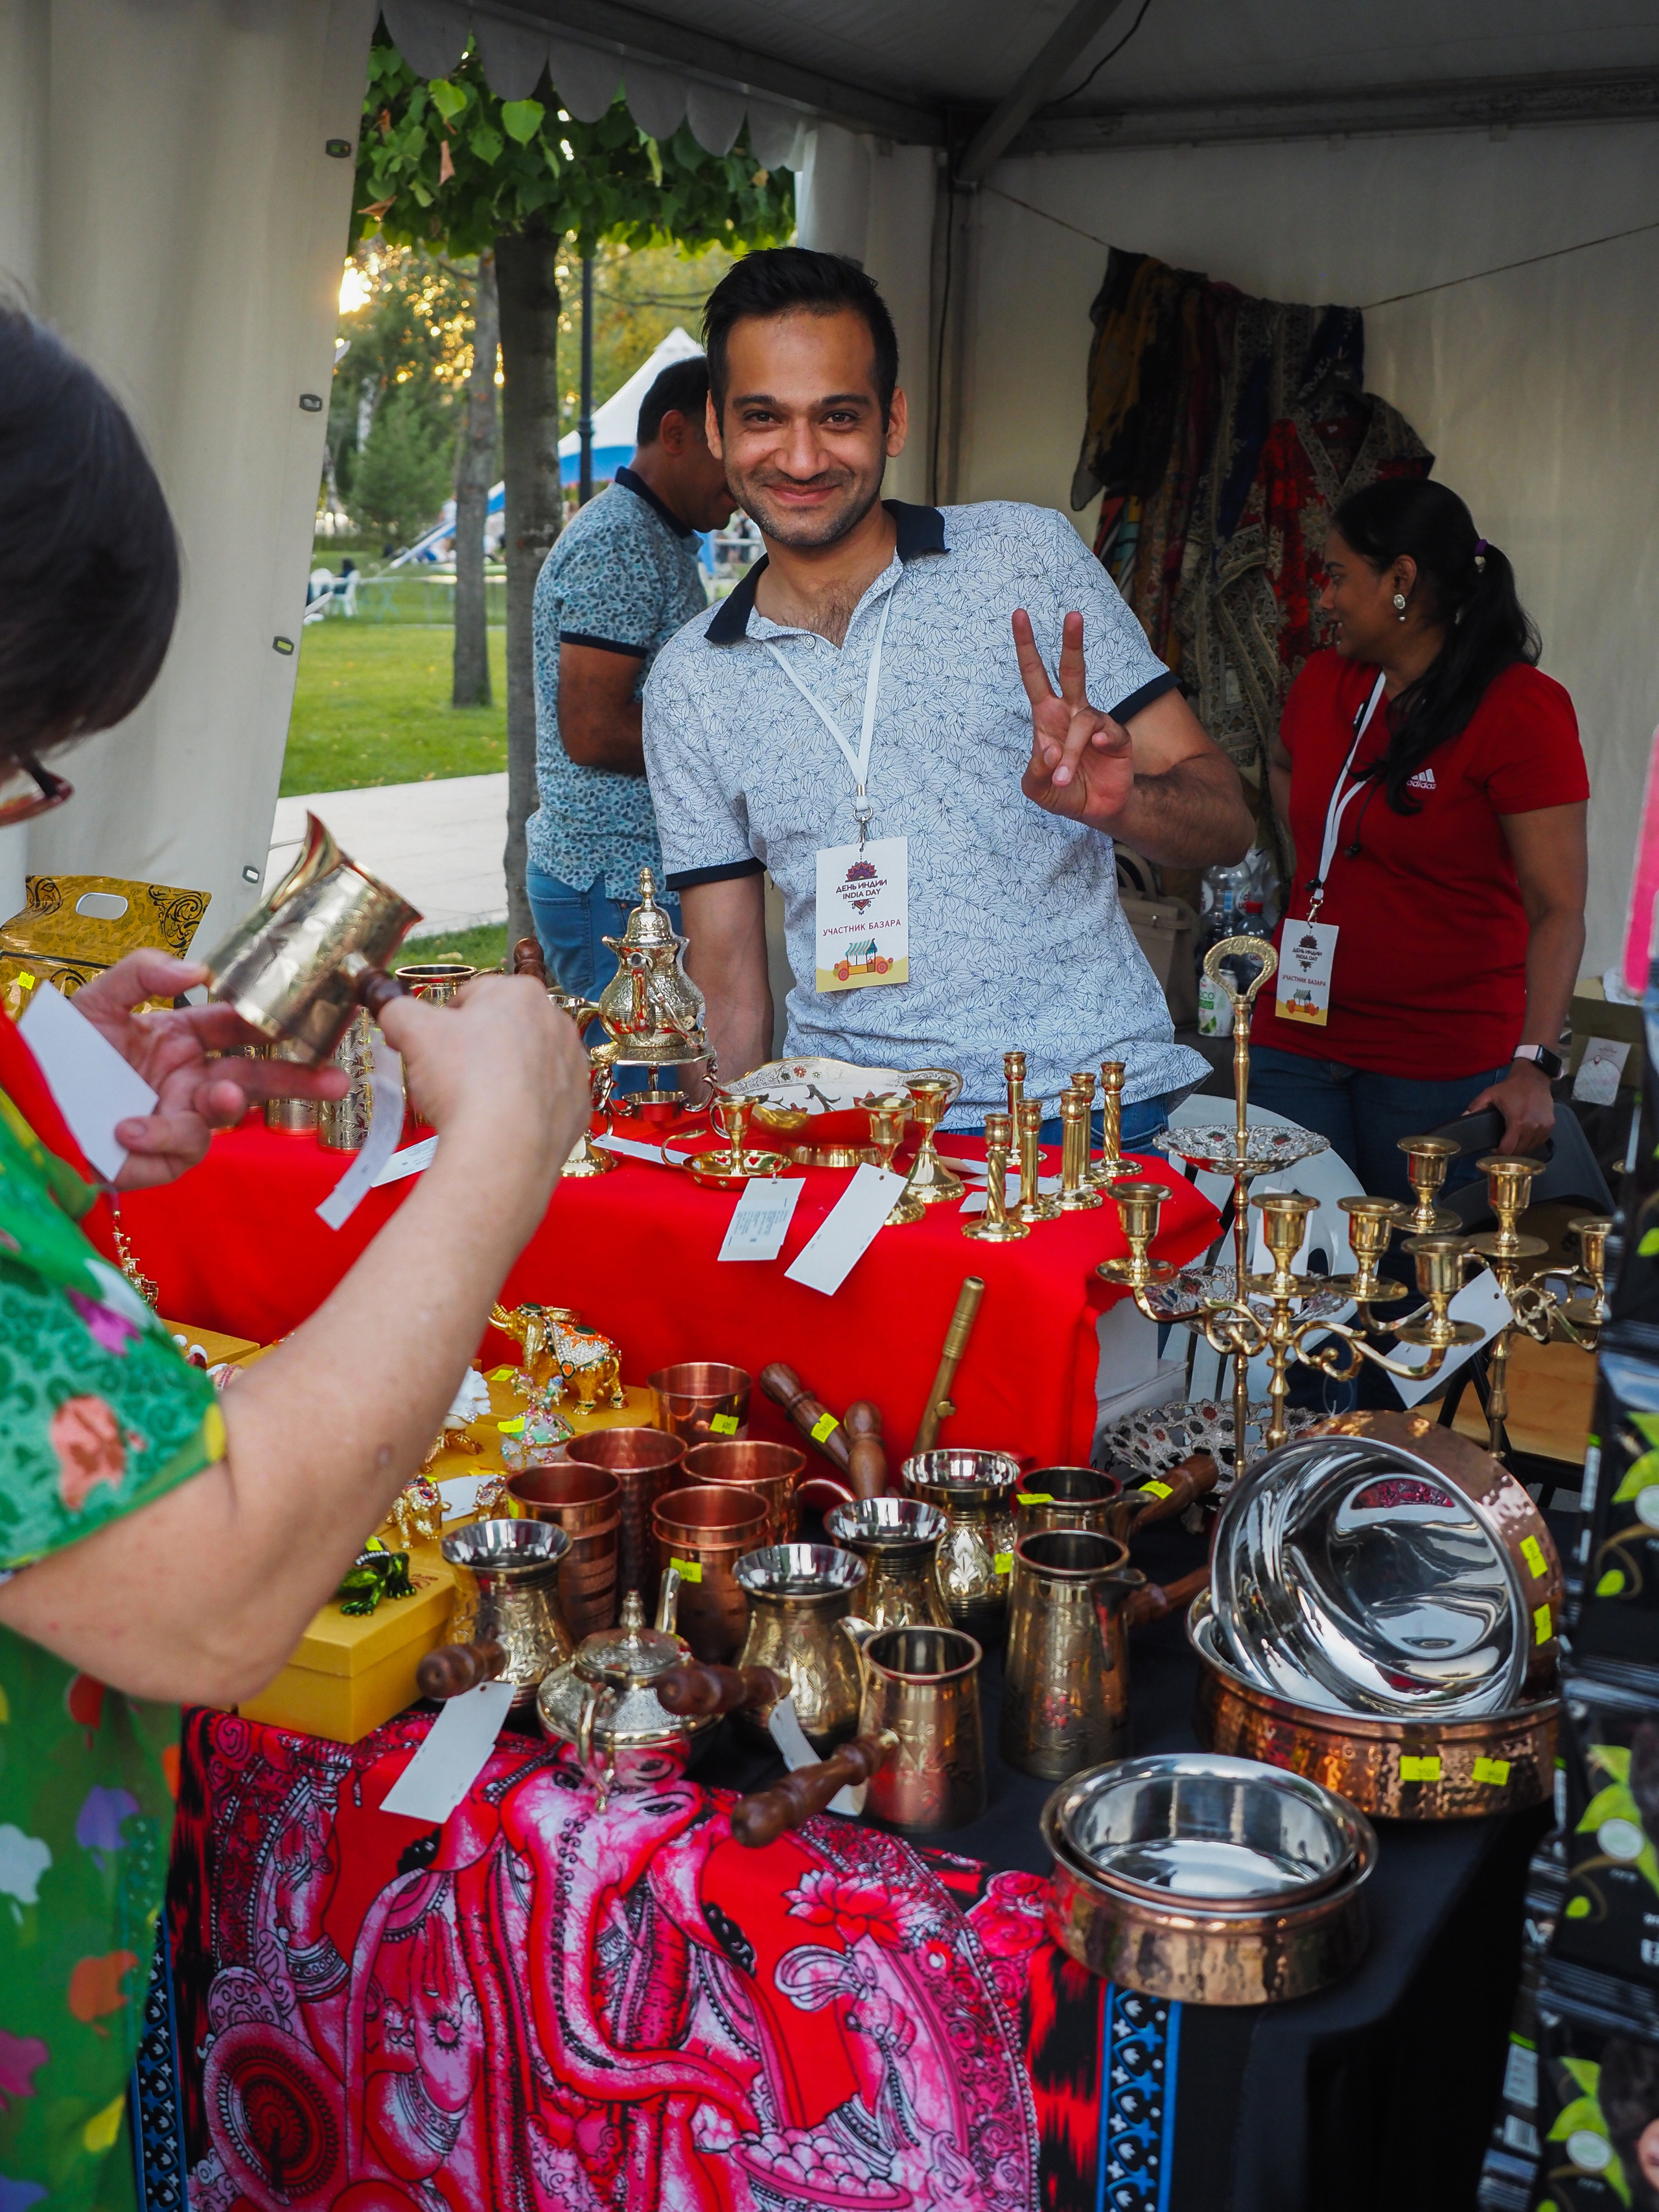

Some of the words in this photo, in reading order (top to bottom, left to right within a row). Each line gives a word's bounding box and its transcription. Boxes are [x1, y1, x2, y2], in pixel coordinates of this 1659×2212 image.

[1406, 780, 1437, 789] adidas
[836, 883, 857, 894] ДЕНЬ
[858, 879, 887, 889] ИНДИИ
[842, 891, 864, 900] INDIA
[865, 888, 881, 896] DAY
[823, 924, 866, 936] УЧАСТНИК
[868, 919, 901, 929] БАЗАРА
[1282, 974, 1306, 983] УЧАСТНИК
